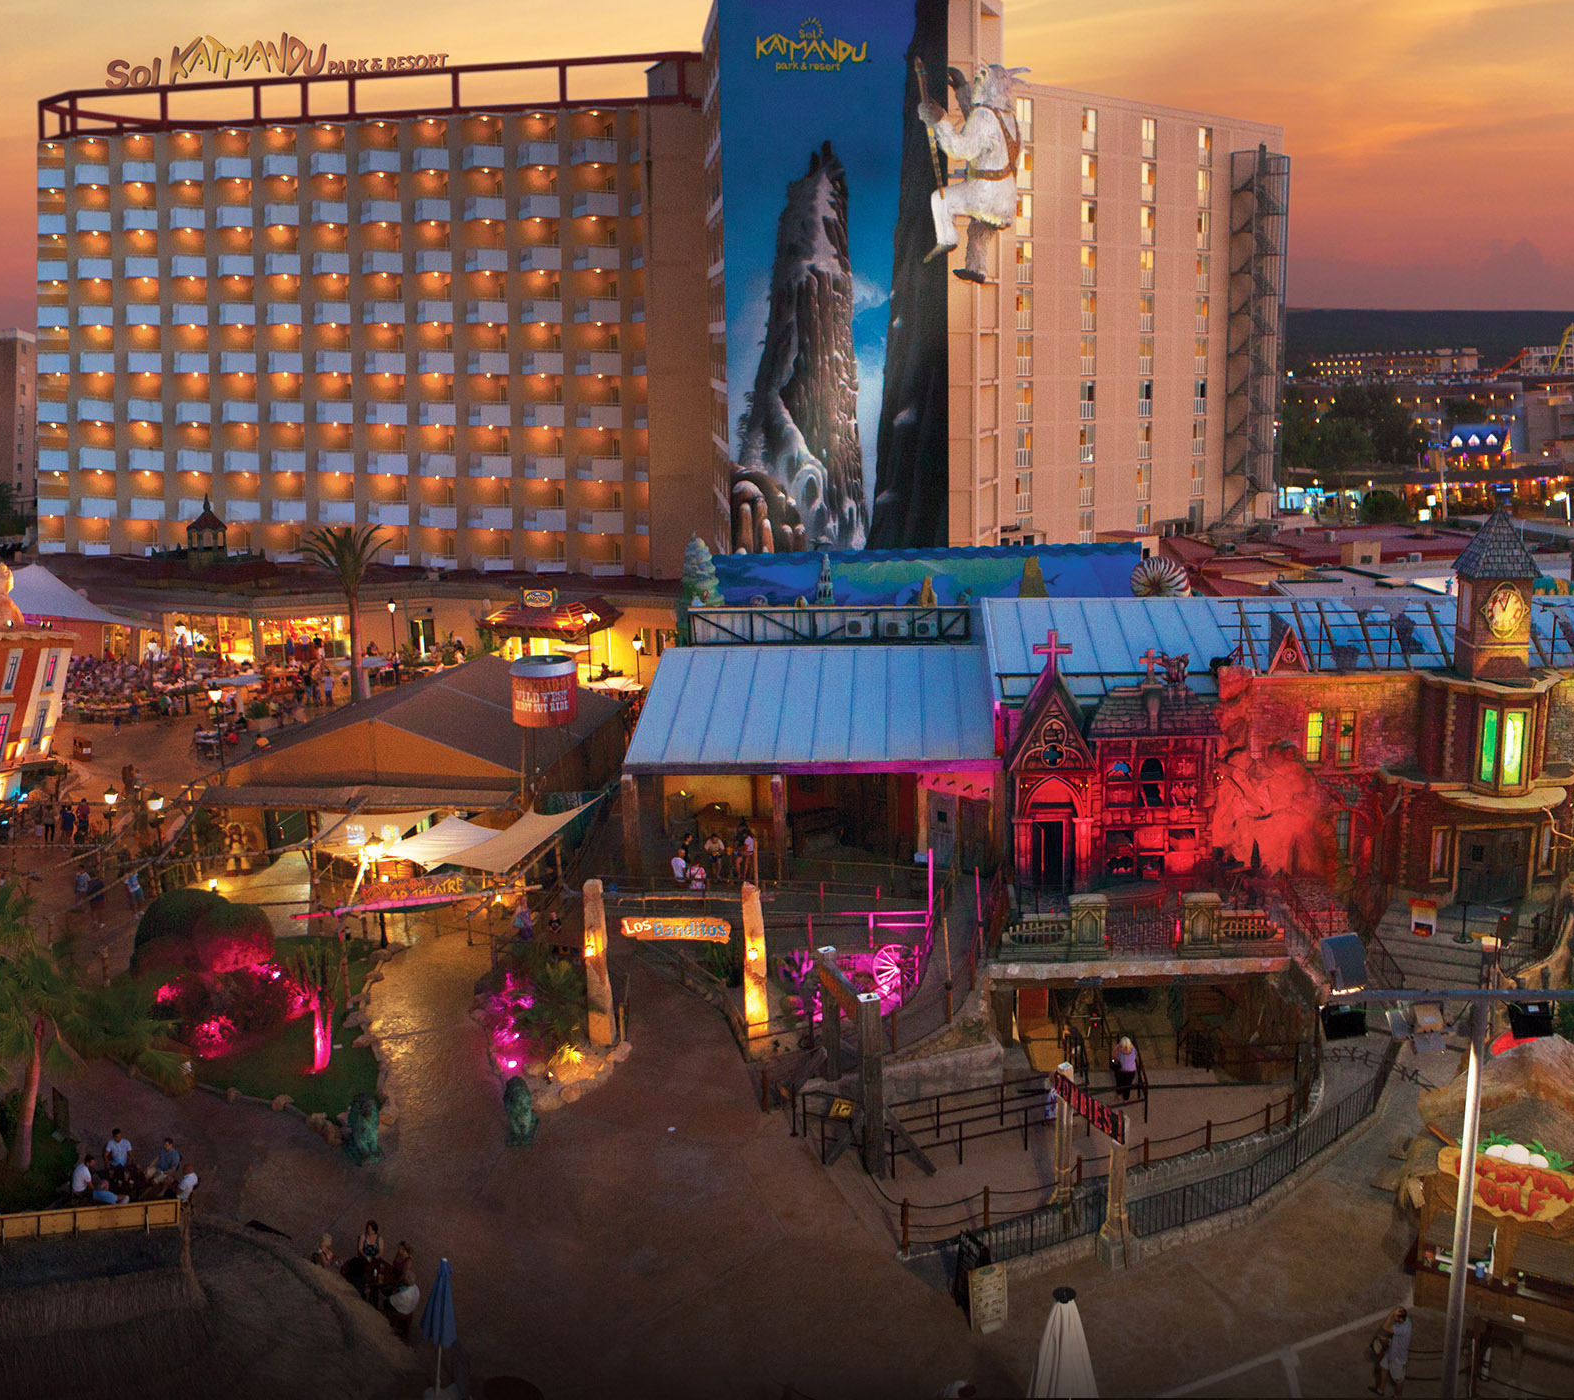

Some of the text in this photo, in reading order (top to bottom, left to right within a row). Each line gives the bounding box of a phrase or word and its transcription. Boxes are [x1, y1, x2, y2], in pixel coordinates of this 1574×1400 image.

[105, 32, 449, 89] Sol KATMANDU PARK & RESORT
[756, 33, 867, 63] KATMANDU
[775, 62, 840, 72] park & resort
[411, 877, 464, 899] THEATRE
[623, 920, 727, 937] Los Banditos
[1478, 1178, 1552, 1217] GOLF
